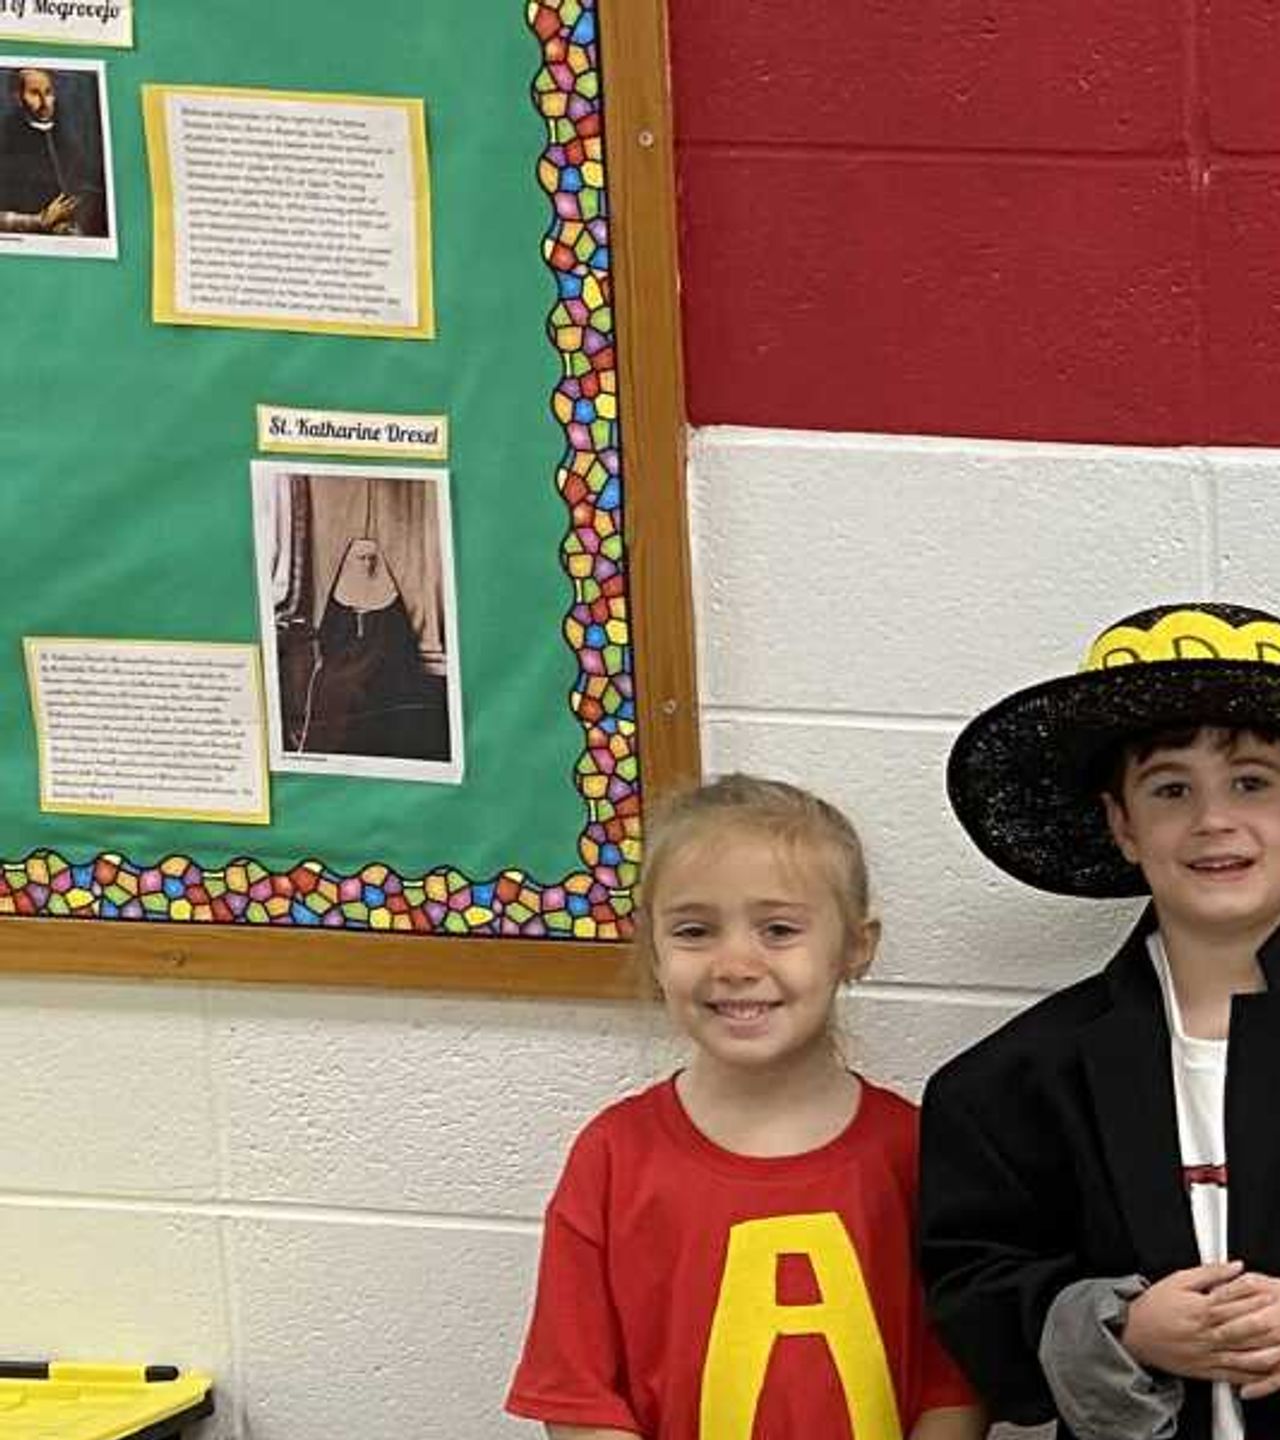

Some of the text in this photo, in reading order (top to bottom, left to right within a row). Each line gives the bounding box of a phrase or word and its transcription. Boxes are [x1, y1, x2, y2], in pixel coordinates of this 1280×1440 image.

[269, 415, 439, 444] St. Katharine Drexel
